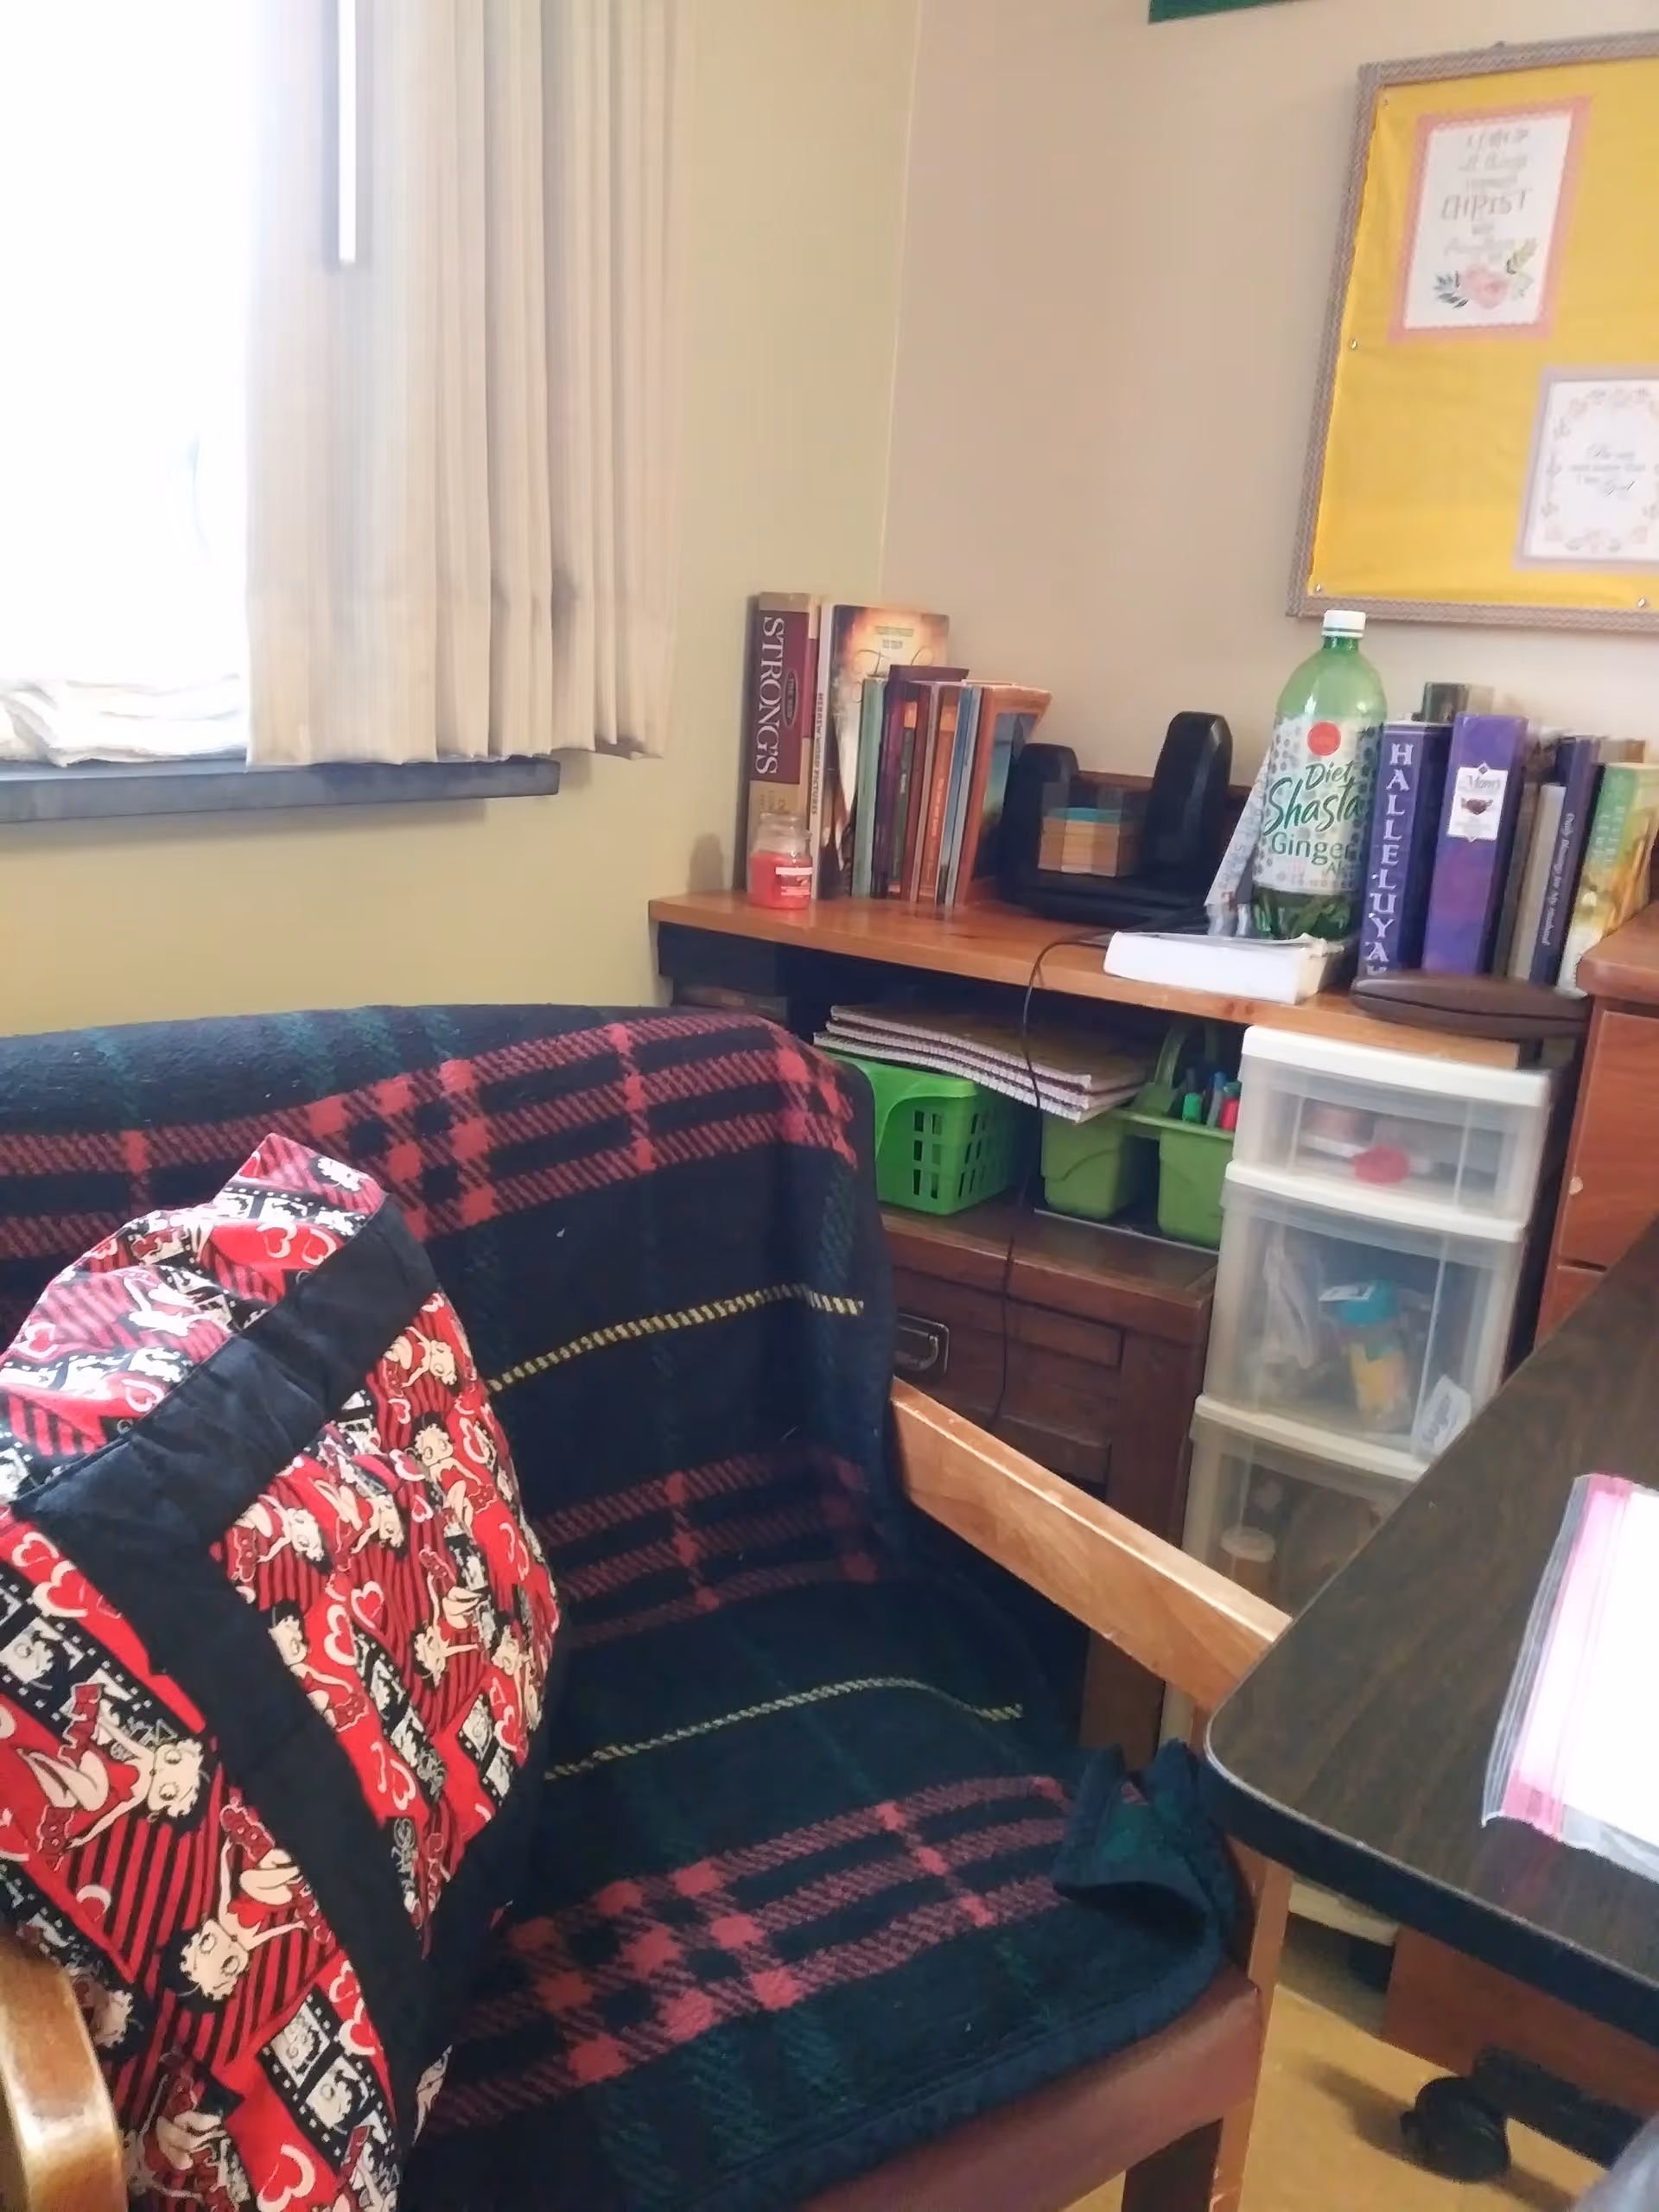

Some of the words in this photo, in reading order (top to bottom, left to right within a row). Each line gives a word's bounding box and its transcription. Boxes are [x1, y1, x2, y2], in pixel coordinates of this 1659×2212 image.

[754, 616, 785, 776] STRONG'S
[811, 770, 820, 816] PICTURES
[1305, 760, 1356, 791] Diet
[1262, 776, 1360, 836] Shasta
[1271, 831, 1355, 866] Ginger
